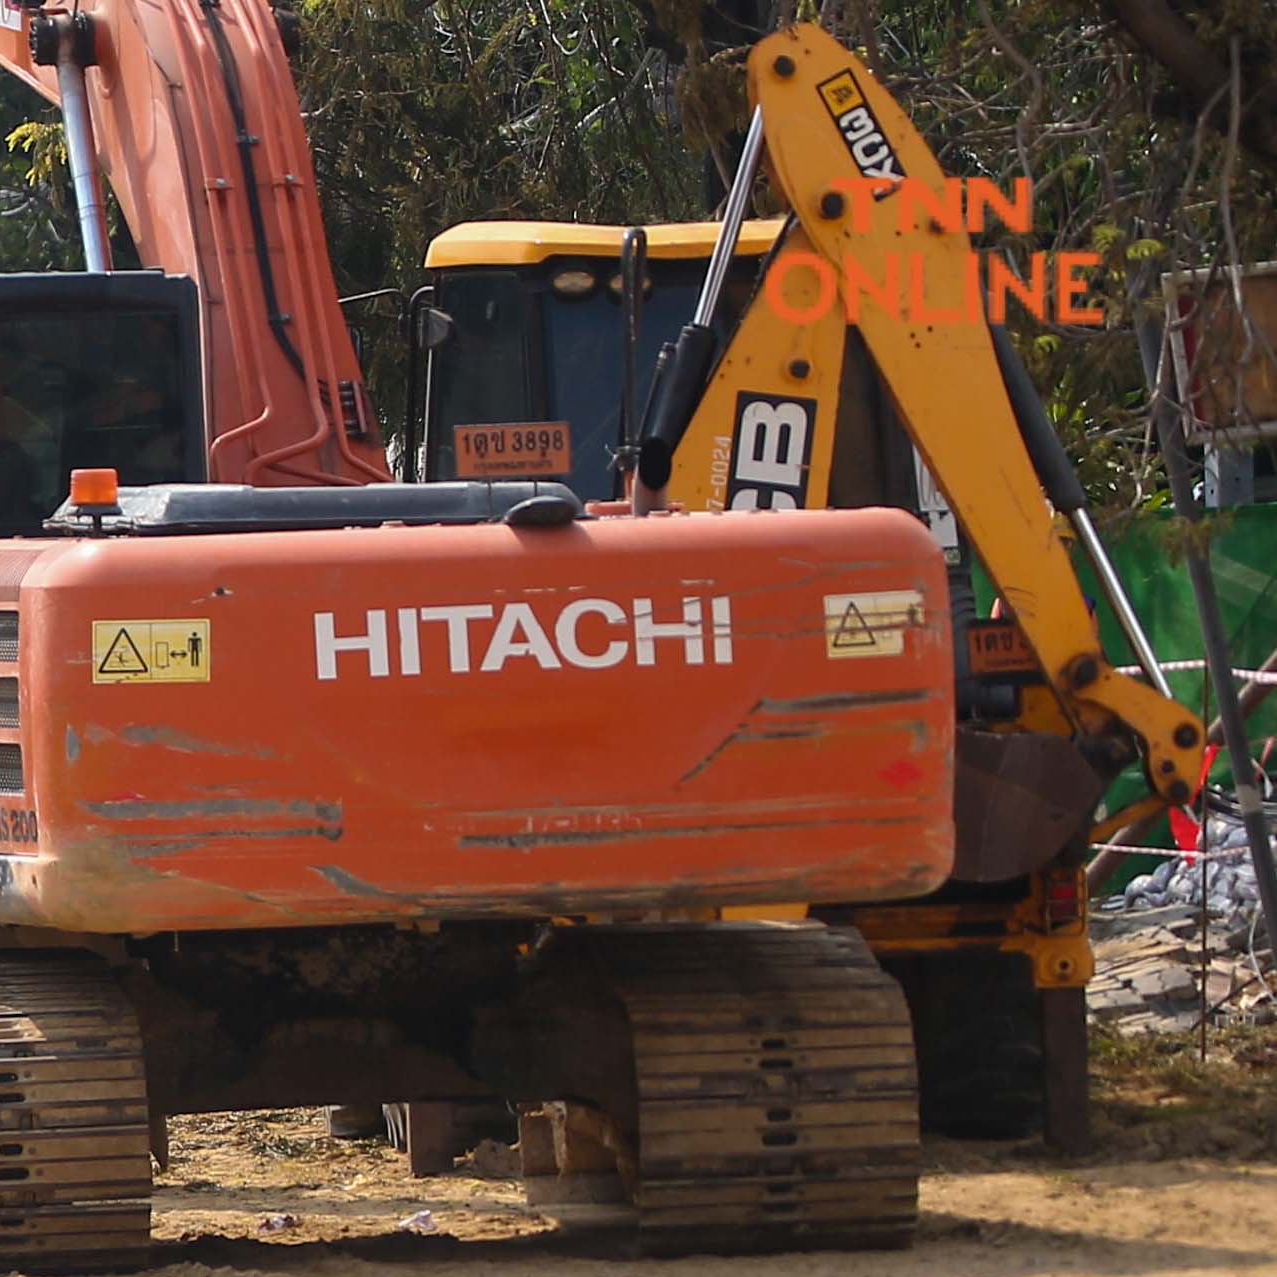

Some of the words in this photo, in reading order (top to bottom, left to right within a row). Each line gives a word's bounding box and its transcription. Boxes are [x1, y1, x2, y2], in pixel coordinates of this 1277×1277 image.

[512, 430, 564, 453] 3898
[314, 597, 733, 680] HITACHI
[10, 808, 38, 842] 200
